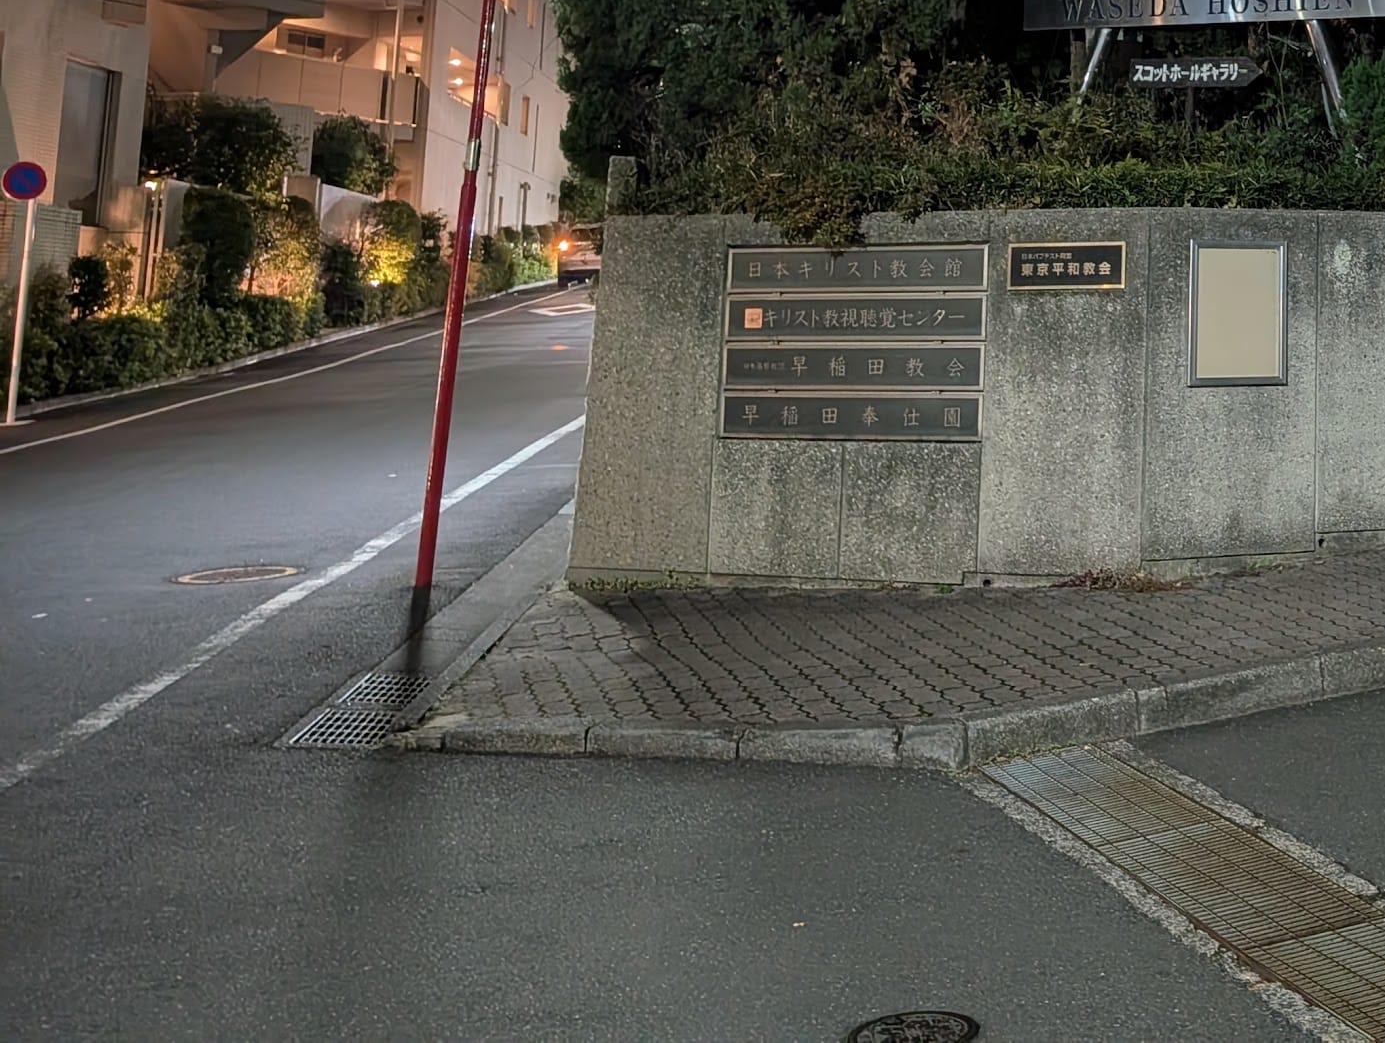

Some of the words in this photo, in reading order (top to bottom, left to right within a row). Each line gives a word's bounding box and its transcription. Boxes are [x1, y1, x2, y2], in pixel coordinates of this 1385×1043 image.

[1132, 62, 1249, 84] スコットホールギャラリー
[748, 257, 963, 278] 日本キリスト教会館
[1020, 261, 1112, 277] 東京平和教会
[763, 307, 966, 329] キリスト教視聴覚センター
[791, 356, 966, 378] 早稲田教会
[742, 404, 961, 428] 早稲田奉仕園
